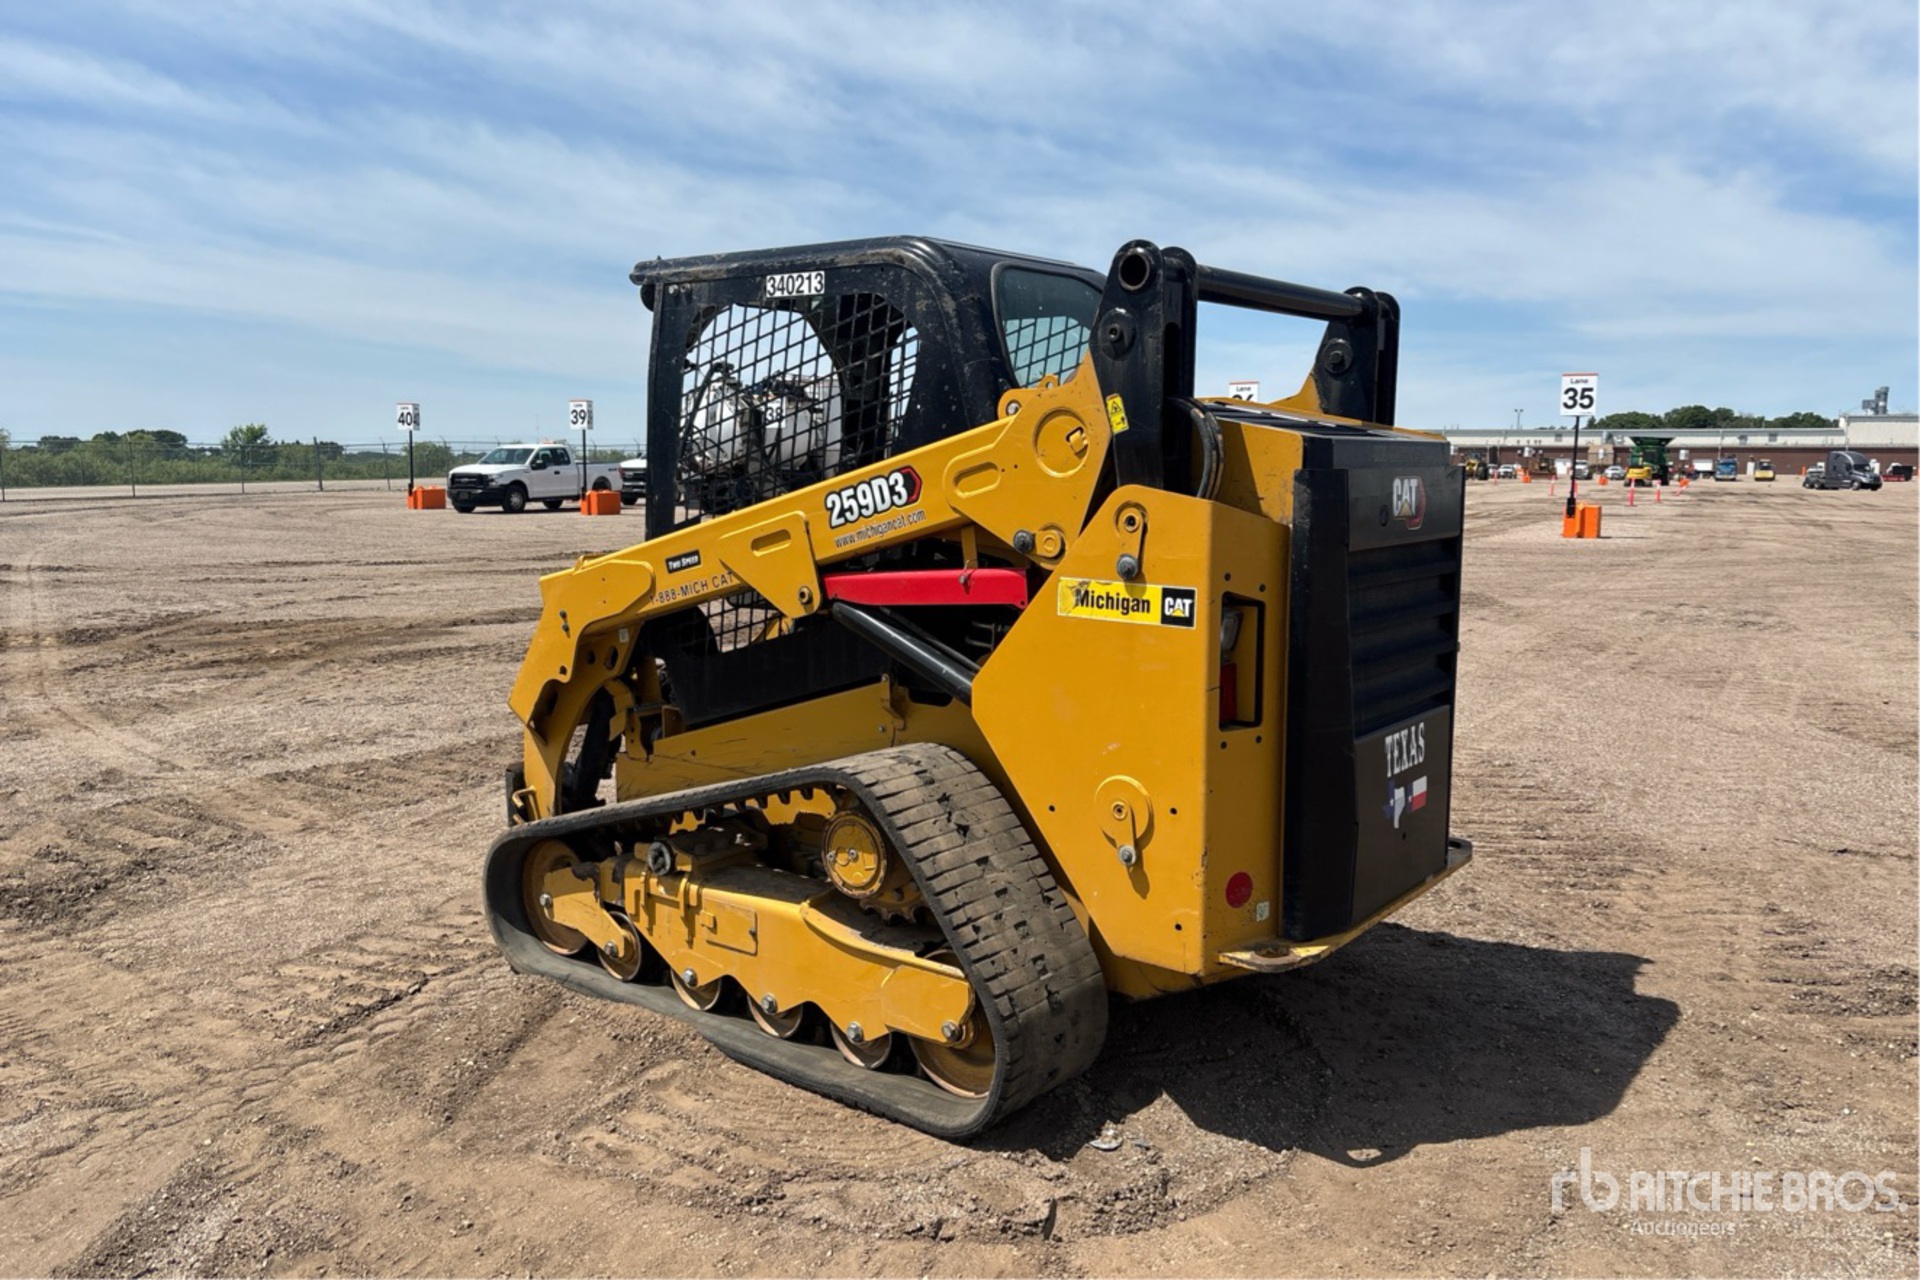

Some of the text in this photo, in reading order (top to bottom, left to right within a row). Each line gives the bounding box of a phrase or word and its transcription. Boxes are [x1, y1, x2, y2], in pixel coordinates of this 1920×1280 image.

[767, 272, 824, 297] 340213
[1562, 387, 1594, 410] 35
[397, 411, 413, 426] 40
[571, 409, 586, 425] 39
[825, 471, 909, 528] 259D3
[1392, 477, 1419, 518] CAT
[834, 510, 926, 549] www.michigancat.com
[649, 570, 735, 605] 1-888-MICH CAT
[1074, 588, 1193, 618] Michigan CAT
[1385, 722, 1425, 778] TEXAS
